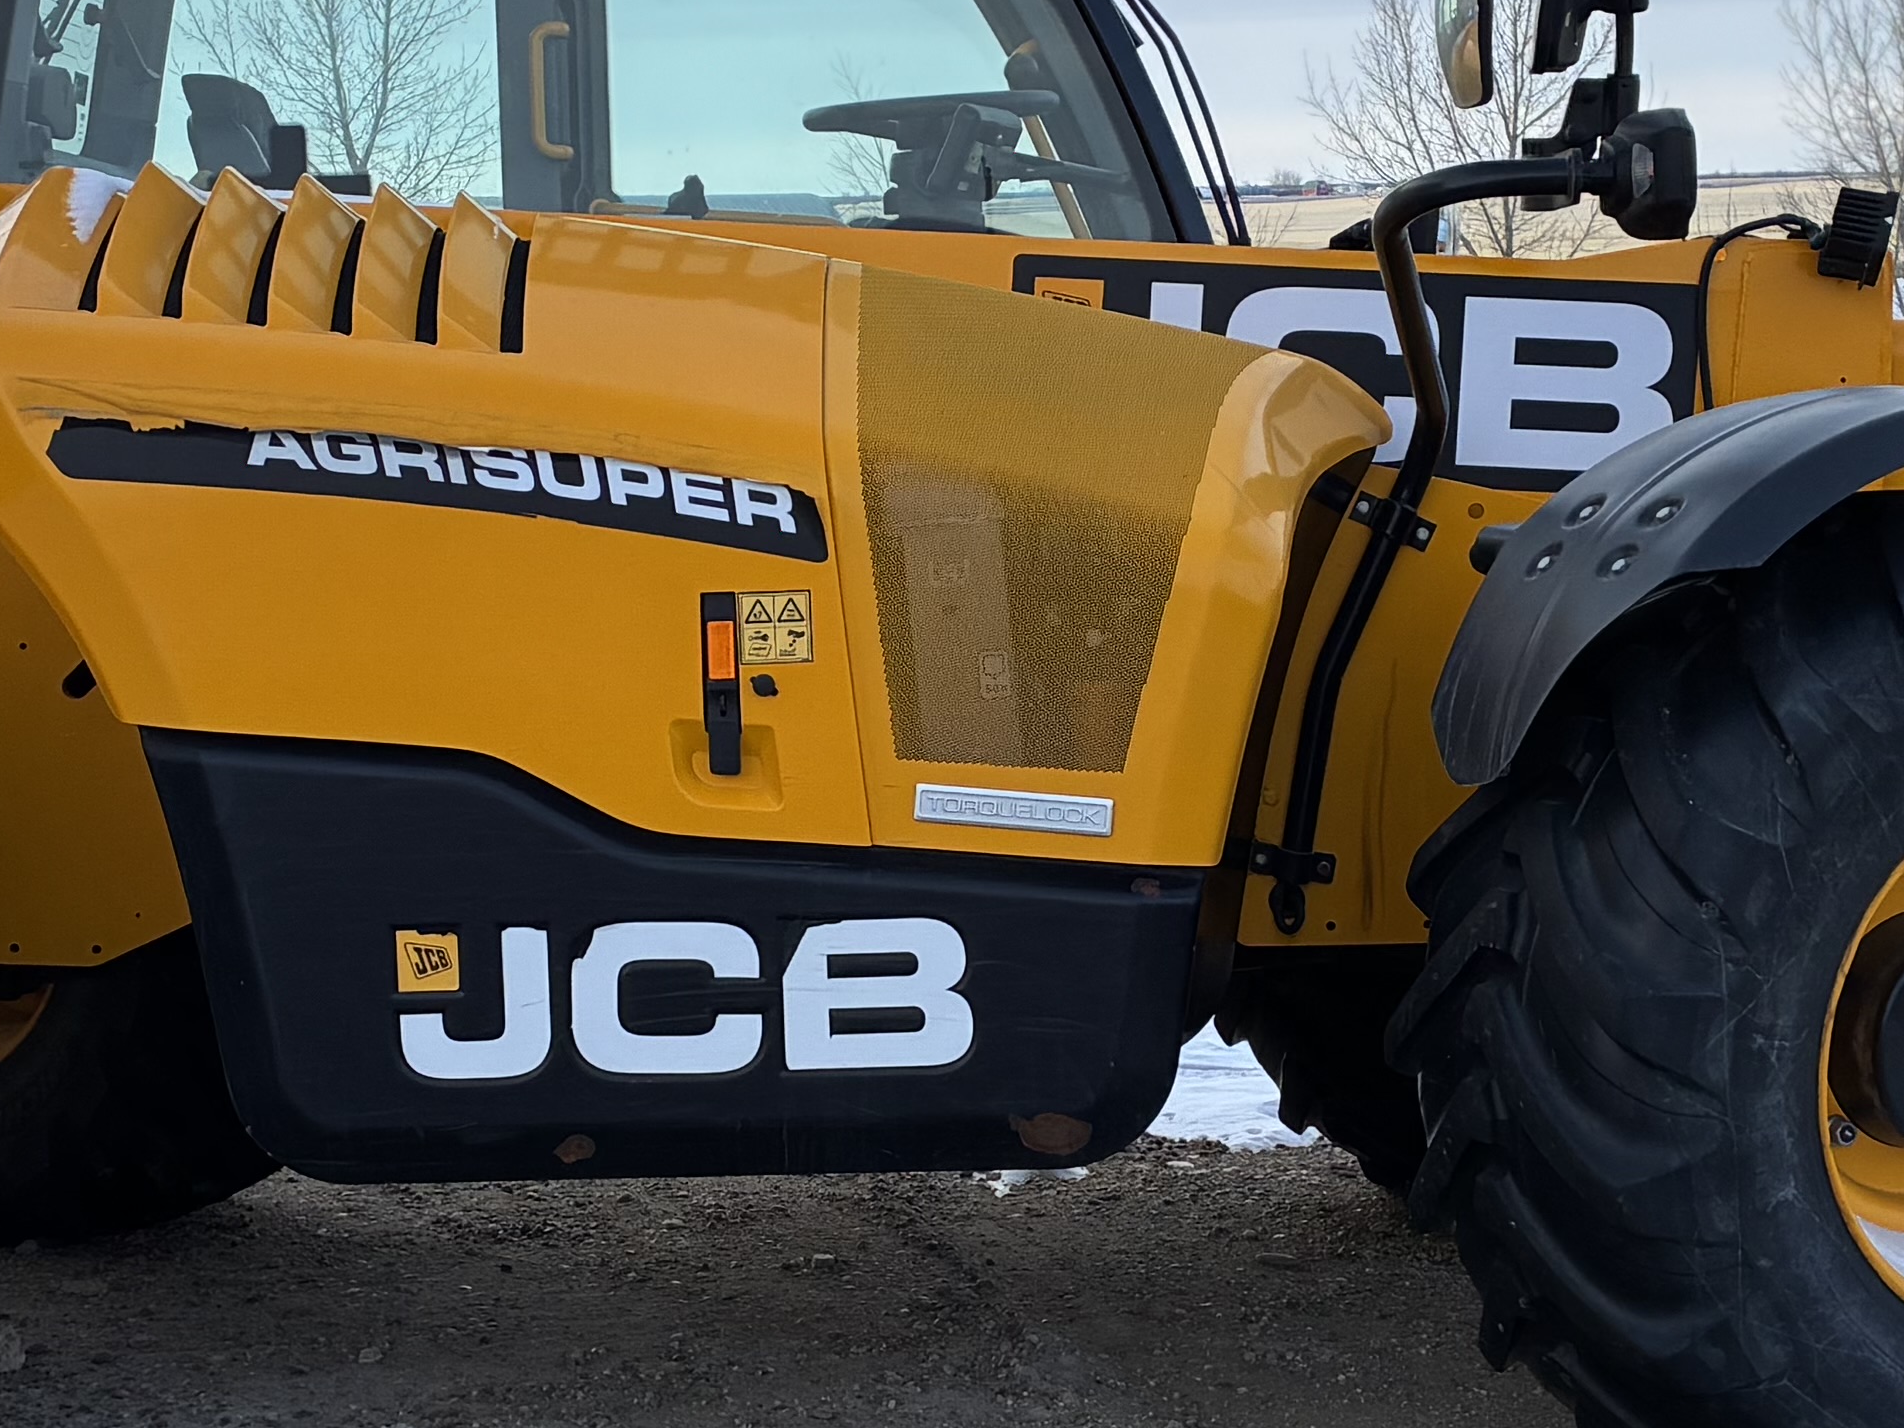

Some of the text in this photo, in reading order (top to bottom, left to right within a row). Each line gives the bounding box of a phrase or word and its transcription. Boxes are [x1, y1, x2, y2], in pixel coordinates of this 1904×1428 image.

[246, 430, 798, 534] AGRISUPER
[926, 795, 1101, 826] TORQUELOCK
[412, 946, 450, 976] JCB
[399, 917, 975, 1080] JCB
